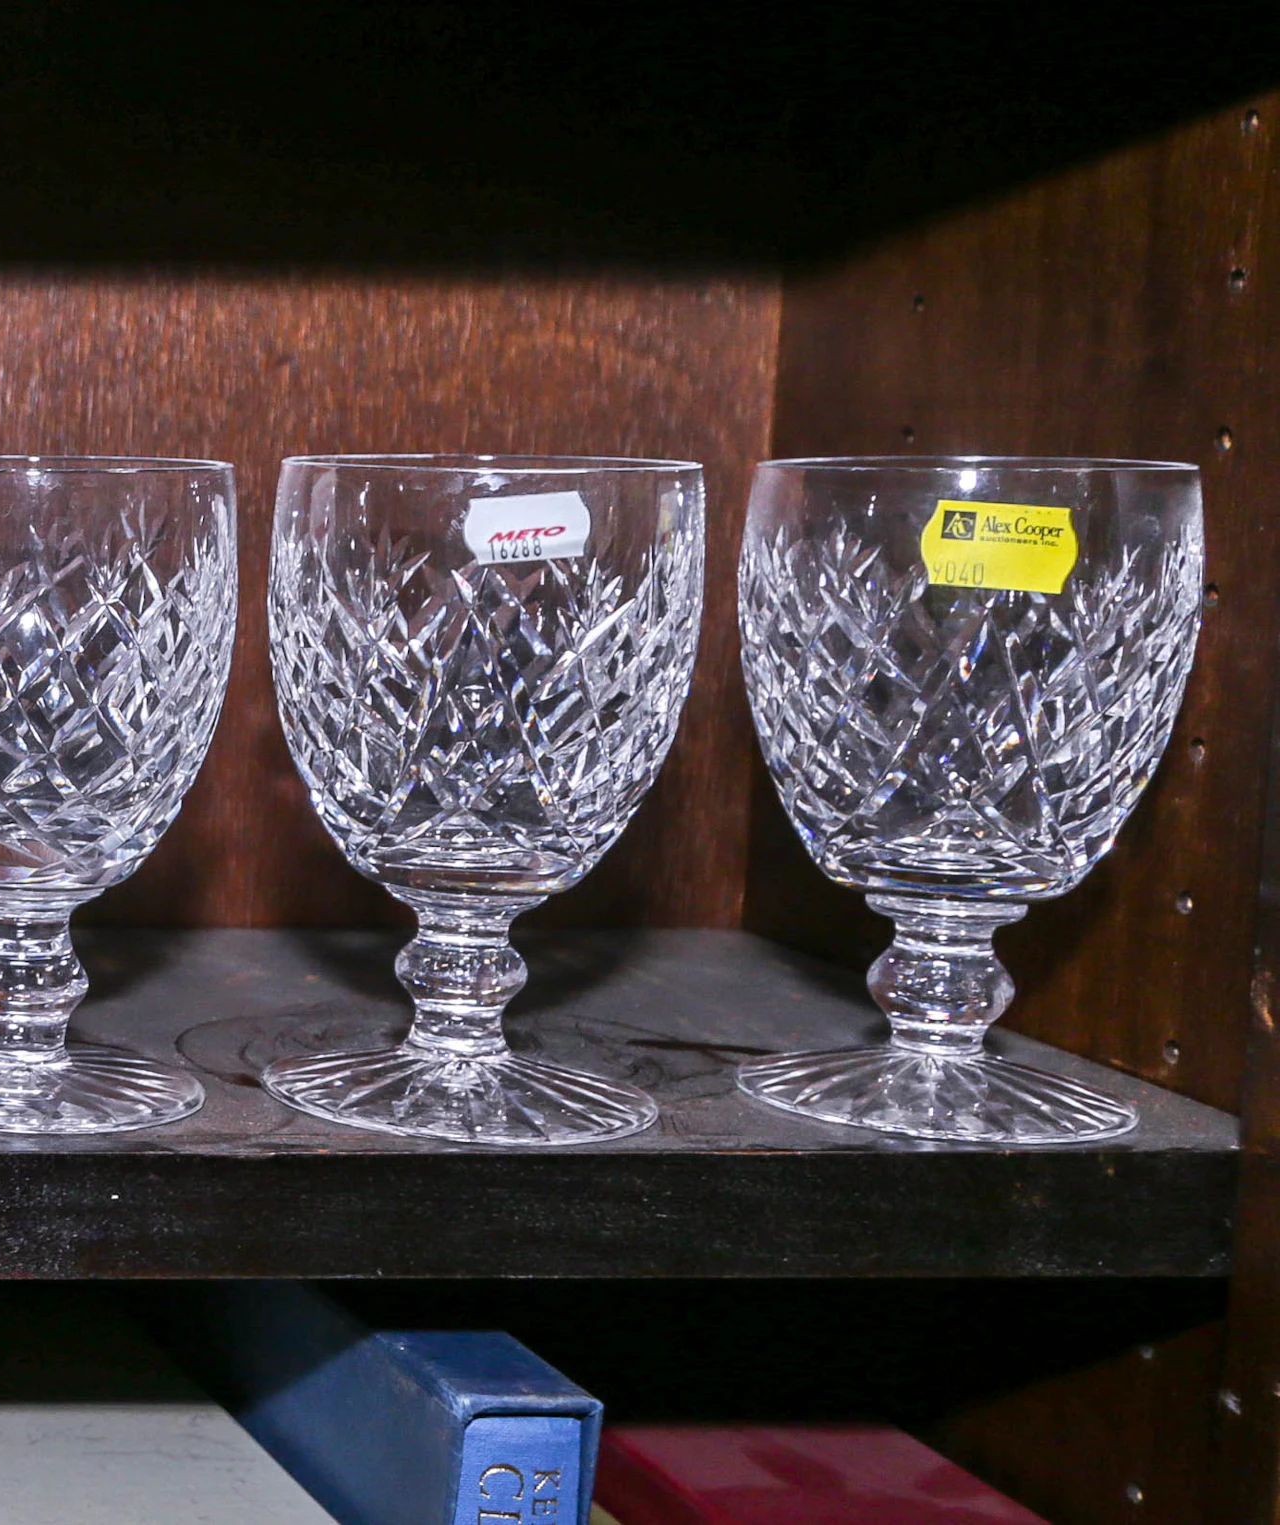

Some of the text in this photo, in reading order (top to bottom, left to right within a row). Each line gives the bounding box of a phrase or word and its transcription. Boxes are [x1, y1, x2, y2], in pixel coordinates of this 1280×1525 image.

[488, 526, 567, 543] METO
[981, 516, 1065, 540] Alex Cooper
[490, 538, 542, 560] 16288
[980, 536, 1038, 546] auctioneers
[532, 1469, 560, 1525] KE
